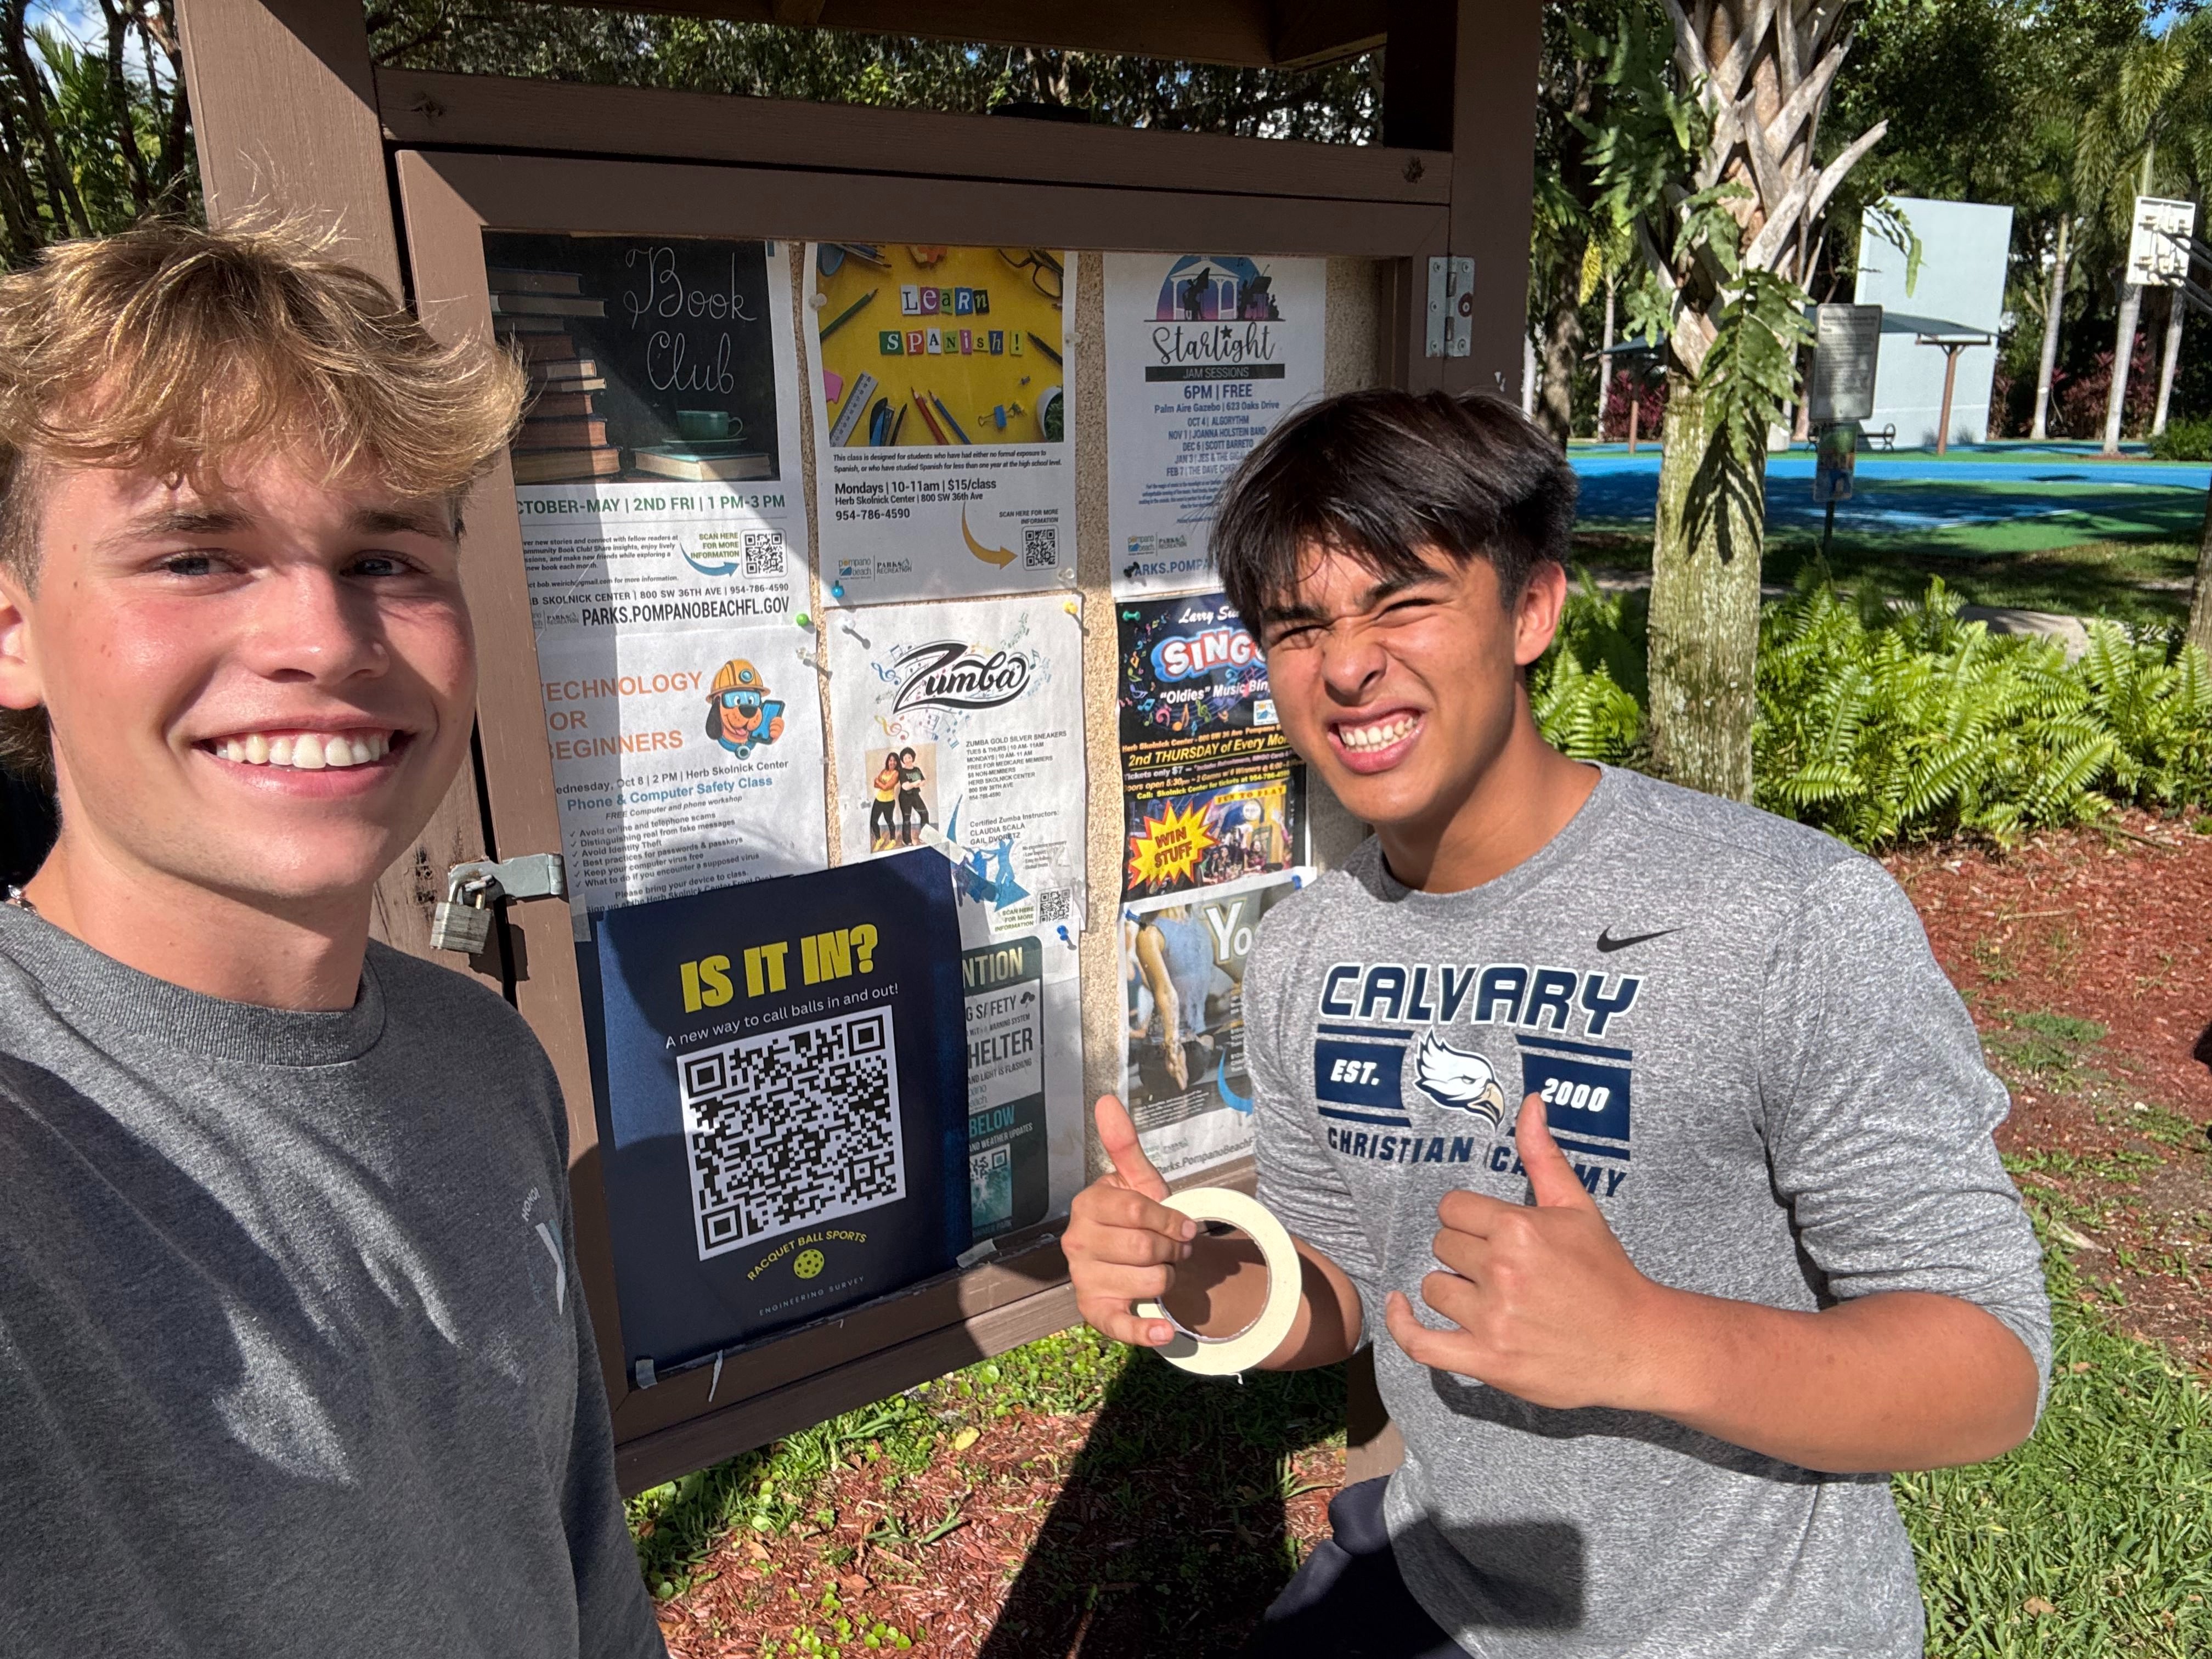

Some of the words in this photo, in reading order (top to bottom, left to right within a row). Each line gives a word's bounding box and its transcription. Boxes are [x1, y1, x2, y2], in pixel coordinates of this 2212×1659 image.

[623, 247, 758, 329] Book
[1153, 321, 1276, 364] Starlight
[646, 331, 734, 394] Club
[1183, 368, 1203, 379] JAM
[1205, 366, 1249, 378] SESSIONS
[1184, 385, 1212, 399] 6PM
[1223, 383, 1252, 398] FREE
[1154, 404, 1175, 414] Palm
[1176, 403, 1191, 413] Aire
[1193, 402, 1221, 412] Gazebo
[1226, 402, 1240, 411] 623
[1242, 401, 1260, 410] Oaks
[1261, 400, 1280, 409] Drive
[1187, 417, 1201, 427] OCT
[1201, 416, 1206, 426] 4
[1211, 415, 1249, 426] ALGORYTHM
[1168, 431, 1183, 440] NOV
[1192, 428, 1218, 439] JOANNA
[1219, 427, 1249, 438] HOLSTEIN
[1250, 426, 1267, 436] BAND
[1182, 442, 1196, 452] DEC
[1205, 441, 1225, 450] SCOTT
[1226, 439, 1254, 449] BARRETO
[834, 482, 884, 496] Mondays
[891, 481, 940, 493] 10-11am
[948, 477, 997, 492] $15/class
[517, 498, 620, 515] CTOBER-MAY
[633, 498, 666, 511] 2ND
[670, 496, 695, 510] FRI
[708, 496, 714, 510] 1
[763, 494, 786, 508] PM
[835, 496, 855, 505] Herb
[856, 495, 889, 505] Skolnick
[890, 495, 915, 504] Center
[921, 494, 936, 502] 800
[938, 493, 950, 501] SW
[952, 492, 969, 501] 36th
[970, 492, 983, 500] Ave
[836, 508, 911, 521] 954-786-4590
[690, 550, 740, 559] INFORMATION
[542, 594, 592, 606] SKOLNICK
[595, 592, 631, 602] CENTER
[640, 590, 657, 599] 800
[661, 590, 675, 598] SW
[678, 588, 702, 597] 36TH
[705, 587, 721, 596] AVE
[730, 583, 789, 594] 954-786-4590
[582, 596, 789, 627] PARKS.POMPANOBEACHFL.GOV
[1178, 606, 1214, 624] Larry
[542, 671, 702, 702] ECHNOLOGY
[893, 640, 1030, 714] Zumba
[1212, 682, 1245, 697] Music
[549, 710, 588, 731] OR
[966, 738, 988, 748] ZUMBA
[991, 737, 1008, 745] GOLD
[1034, 730, 1066, 740] SNEAKERS
[967, 763, 982, 771] FREE
[996, 759, 1024, 767] MEDICARE
[1025, 755, 1053, 764] MEMBERS
[1128, 752, 1152, 767] 2nd
[1155, 742, 1220, 763] THURSDAY
[1220, 740, 1233, 754] of
[1233, 737, 1265, 751] Every
[556, 781, 614, 794] ednesday,
[616, 777, 635, 788] Oct
[637, 776, 644, 785] 8
[653, 774, 659, 783] 2
[662, 772, 678, 782] PM
[686, 768, 709, 780] Herb
[712, 763, 754, 776] Skolnick
[757, 760, 789, 771] Center
[1153, 769, 1170, 778] only
[1172, 766, 1184, 775] $7
[567, 798, 613, 811] Phone
[617, 794, 627, 805] &
[630, 787, 693, 803] Computer
[697, 781, 735, 794] Safety
[738, 777, 772, 789] Class
[1156, 787, 1187, 797] Skolnick
[1188, 785, 1207, 793] Center
[606, 811, 628, 820] FREE
[630, 804, 666, 819] Computer
[668, 803, 682, 811] and
[684, 800, 707, 811] phone
[708, 795, 742, 805] workshop
[970, 818, 997, 828] Certified
[998, 814, 1021, 823] Zumba
[1023, 810, 1059, 820] Instructors:
[970, 827, 1001, 837] CLAUDIA
[1002, 823, 1025, 832] SCALA
[970, 837, 987, 845] GAIL
[989, 832, 1021, 843] DVORETZ
[1154, 826, 1187, 849] WIN
[1154, 840, 1193, 868] STUFF
[995, 921, 1034, 932] INFORMATION
[680, 954, 734, 1014] IS
[743, 941, 788, 998] IT
[800, 923, 878, 986] IN?
[1318, 962, 1645, 1039] CALVARY
[665, 1035, 676, 1049] A
[679, 1028, 710, 1046] new
[712, 1020, 741, 1035] way
[744, 1014, 759, 1028] to
[763, 1007, 788, 1024] call
[791, 998, 824, 1017] balls
[827, 996, 840, 1009] in
[843, 988, 868, 1005] and
[872, 983, 899, 999] out!
[968, 1027, 1034, 1069] HELTER
[980, 1068, 997, 1082] LIGHT
[1005, 1058, 1032, 1074] FLASHING
[1330, 1059, 1380, 1086] EST.
[1541, 1077, 1610, 1112] 2000
[969, 1105, 1015, 1139] BELOW
[981, 1132, 1008, 1150] WEATHER
[1328, 1127, 1475, 1164] CHRISTIAN
[747, 1240, 795, 1281] RACQUET
[797, 1232, 823, 1246] BALL
[826, 1230, 868, 1243] SPORTS
[759, 1289, 824, 1316] ENGINEERING
[829, 1276, 865, 1293] SURVEY
